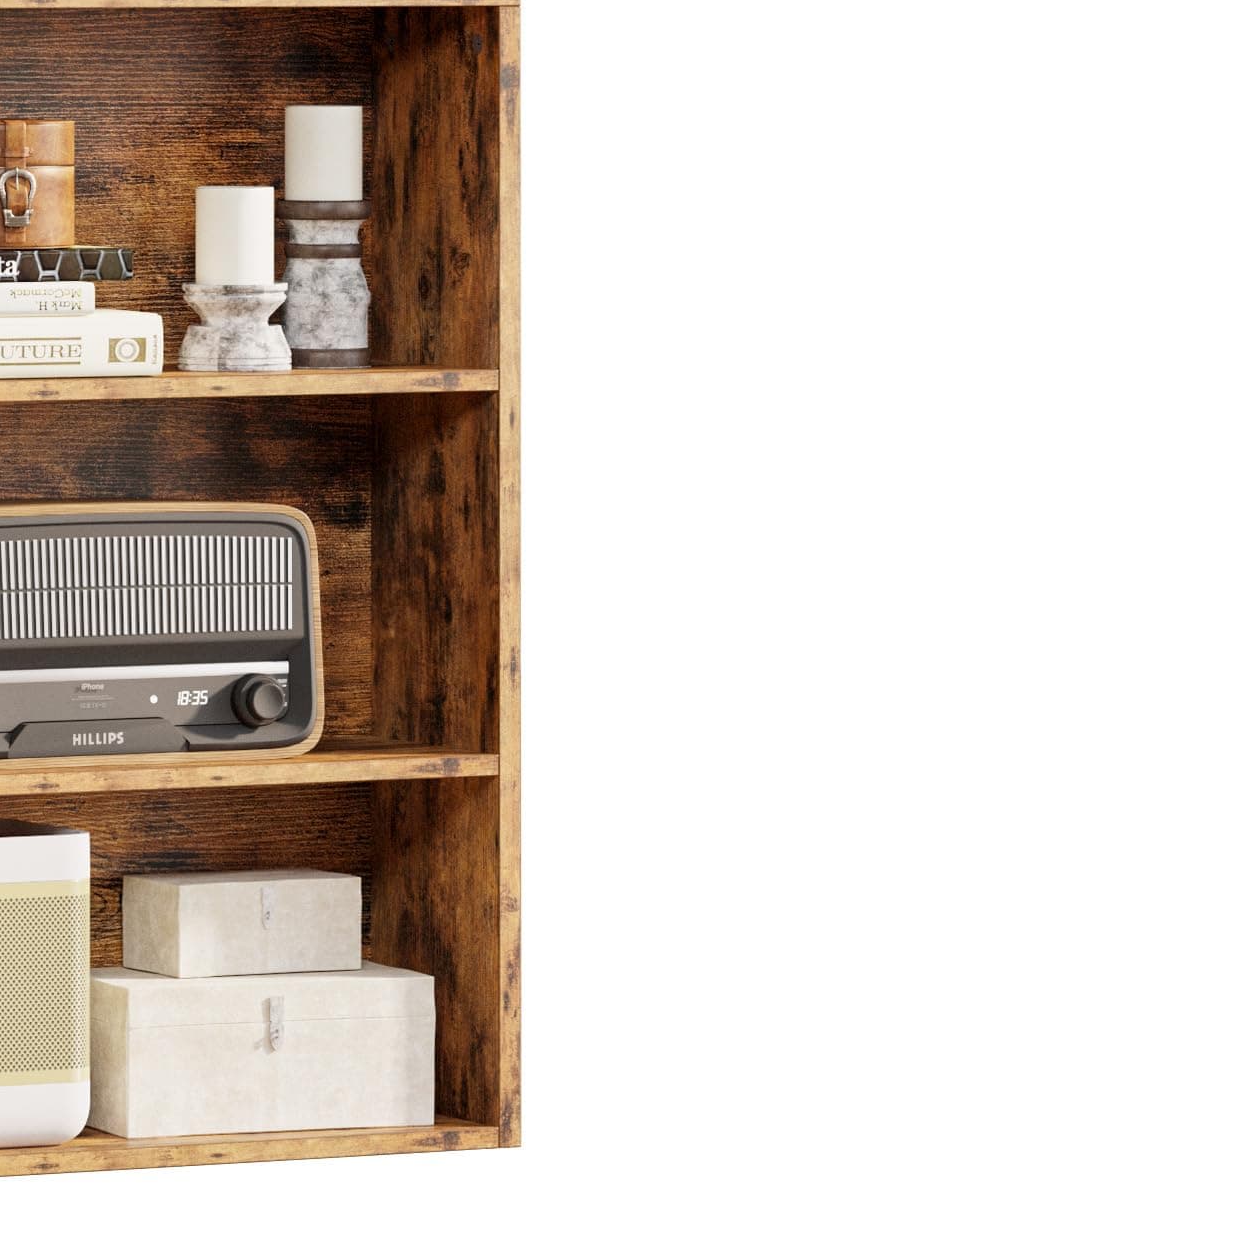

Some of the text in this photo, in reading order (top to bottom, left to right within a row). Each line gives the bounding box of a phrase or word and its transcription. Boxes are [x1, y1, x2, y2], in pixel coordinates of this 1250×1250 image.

[9, 288, 82, 299] McCormack
[51, 301, 82, 311] Mark
[81, 682, 104, 692] iPhone
[177, 690, 208, 706] 18:35
[72, 731, 125, 746] HILLIPS
